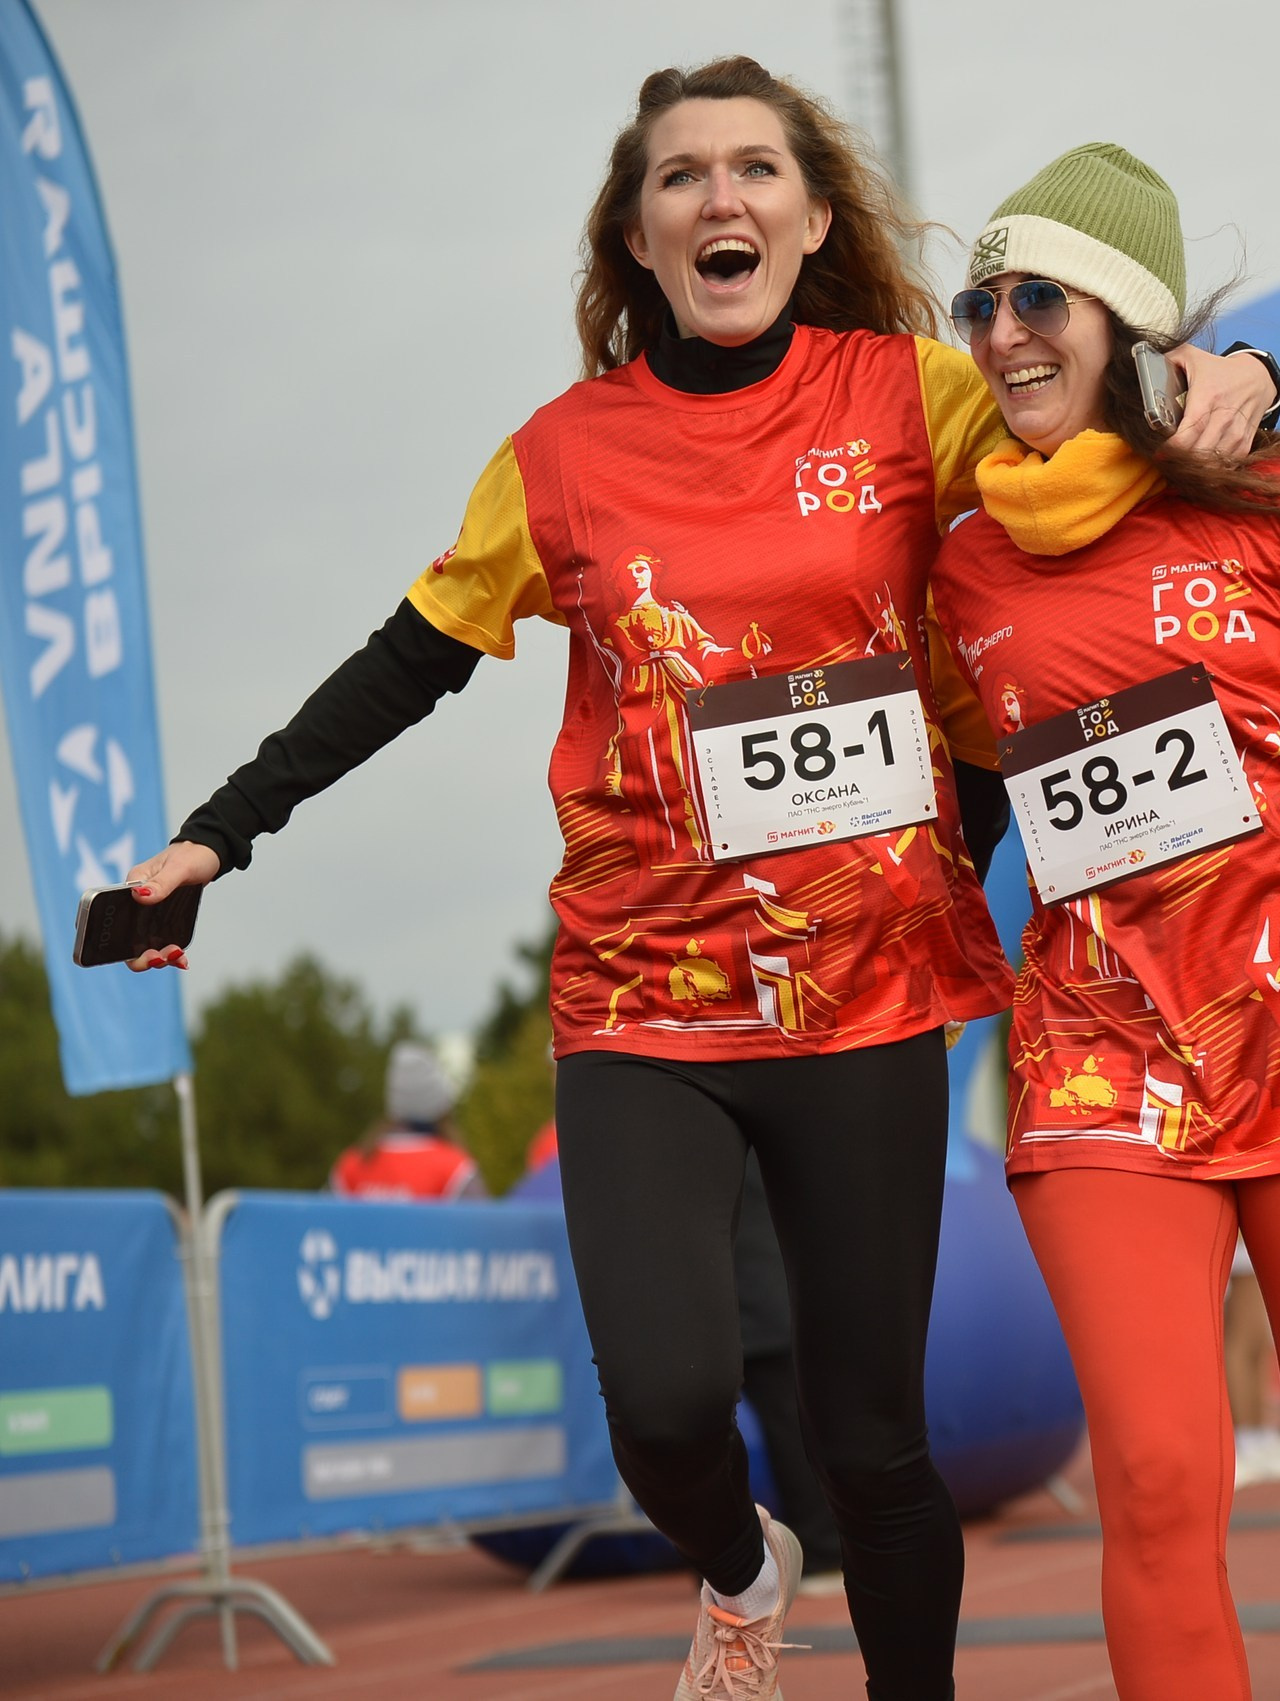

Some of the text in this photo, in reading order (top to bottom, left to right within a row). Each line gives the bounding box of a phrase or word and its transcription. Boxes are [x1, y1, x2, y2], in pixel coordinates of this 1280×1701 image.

[970, 262, 1005, 285] PANTONE
[797, 484, 883, 516] РОД
[1170, 561, 1218, 574] МАГНИТ
[1154, 609, 1256, 645] РОД
[791, 690, 829, 709] РОД
[1083, 720, 1120, 742] РОД
[741, 709, 896, 791] 58-1
[909, 709, 926, 781] ЭСТАФЕТА
[1208, 722, 1239, 793] ЭСТАФЕТА
[705, 748, 723, 819] ЭСТАФЕТА
[1040, 728, 1208, 831] 58-2
[791, 783, 861, 806] ОКСАНА
[787, 810, 803, 818] ПАО
[861, 809, 892, 820] ВЫСШАЯ
[861, 818, 880, 826] ЛИГА
[1104, 809, 1160, 838] ИРИНА
[780, 827, 815, 839] МАГНИТ
[1019, 792, 1046, 863] ЭСТАФЕТА
[1170, 827, 1204, 844] ВЫСШАЯ
[1099, 842, 1113, 852] ПАО
[1171, 838, 1191, 850] ЛИГА
[1096, 857, 1126, 874] МАГНИТ
